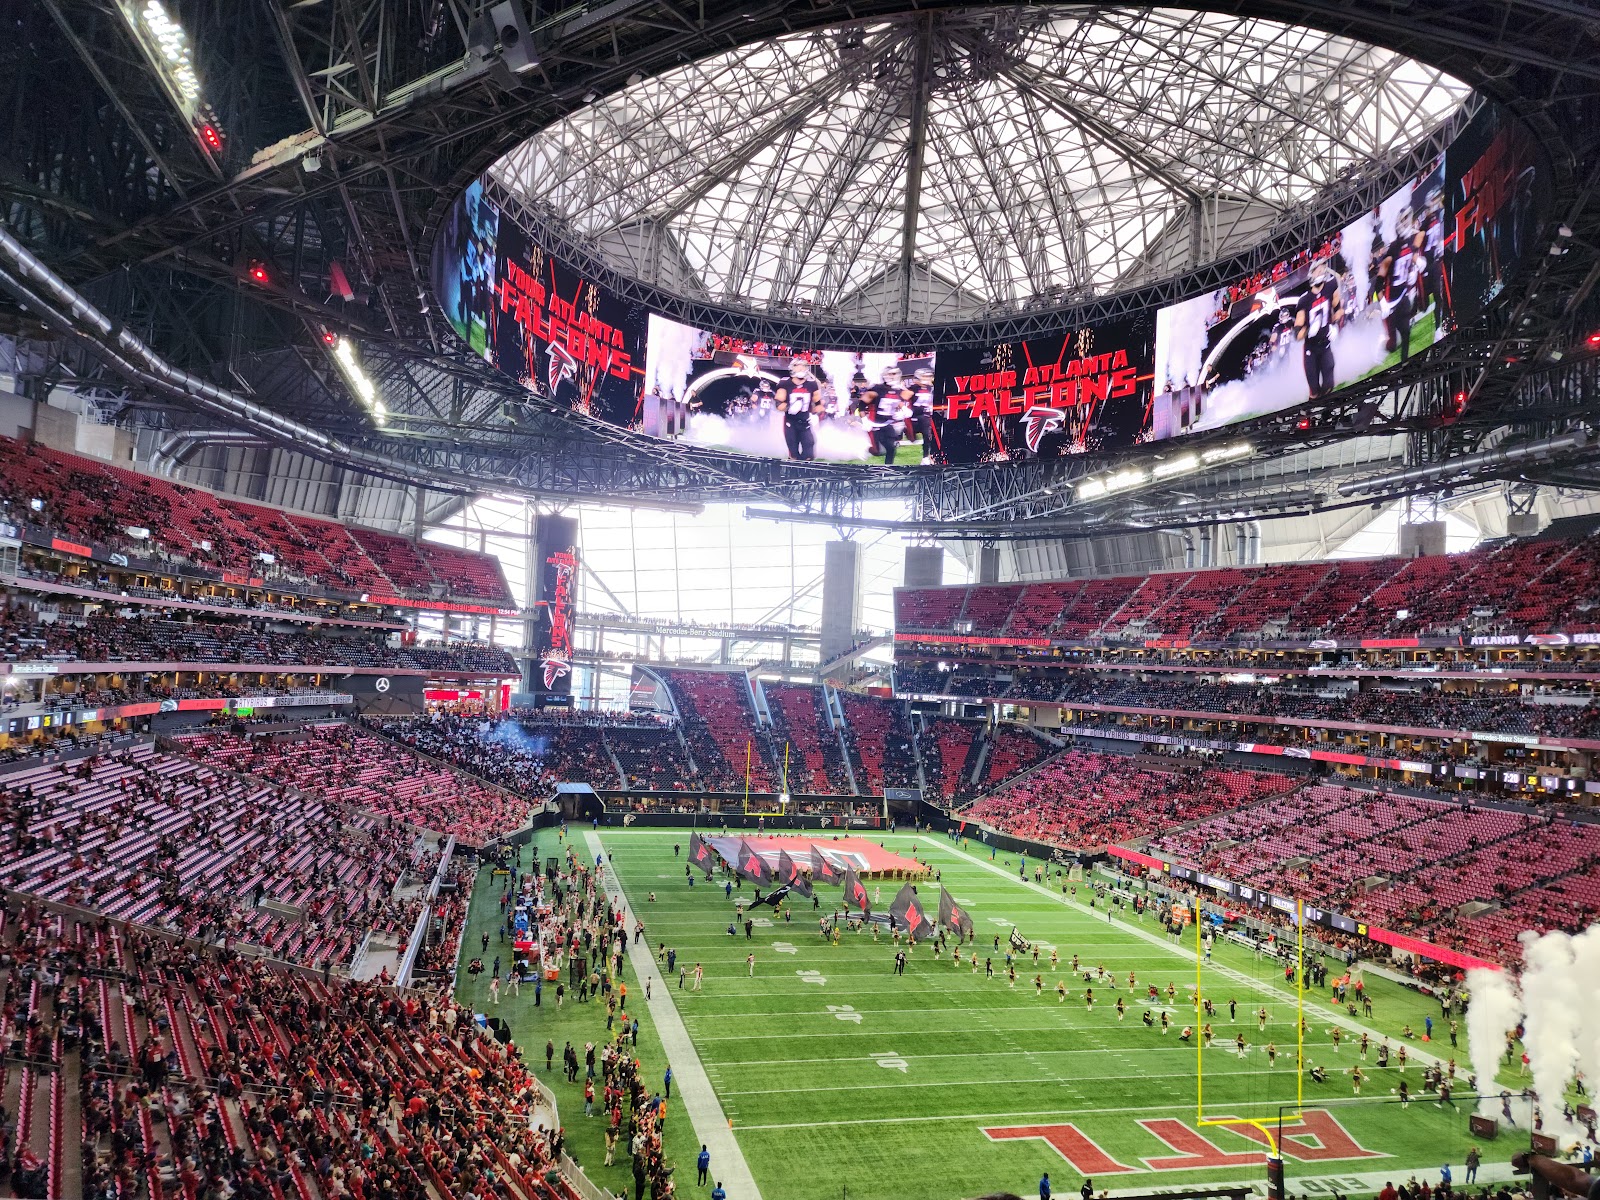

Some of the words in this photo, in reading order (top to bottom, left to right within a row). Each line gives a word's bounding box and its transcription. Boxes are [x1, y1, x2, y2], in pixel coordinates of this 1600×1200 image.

[507, 257, 546, 306] YOUR
[549, 293, 625, 350] ATLANTA
[501, 278, 631, 381] FALCONS
[954, 371, 1017, 393] YOUR
[1023, 349, 1128, 385] ATLANTA
[947, 367, 1137, 420] FALCONS
[655, 626, 706, 636] Mercedes-Benz
[707, 629, 736, 638] Stadium
[1470, 635, 1519, 645] ATLANTA
[1472, 732, 1513, 742] Mercedes-Benz
[1513, 735, 1538, 744] Stadium
[1273, 898, 1295, 911] FALCONS
[796, 969, 828, 987] 30
[826, 1004, 864, 1025] 20
[869, 1051, 910, 1074] 10
[977, 1108, 1400, 1178] ATL
[1299, 1176, 1371, 1194] END
